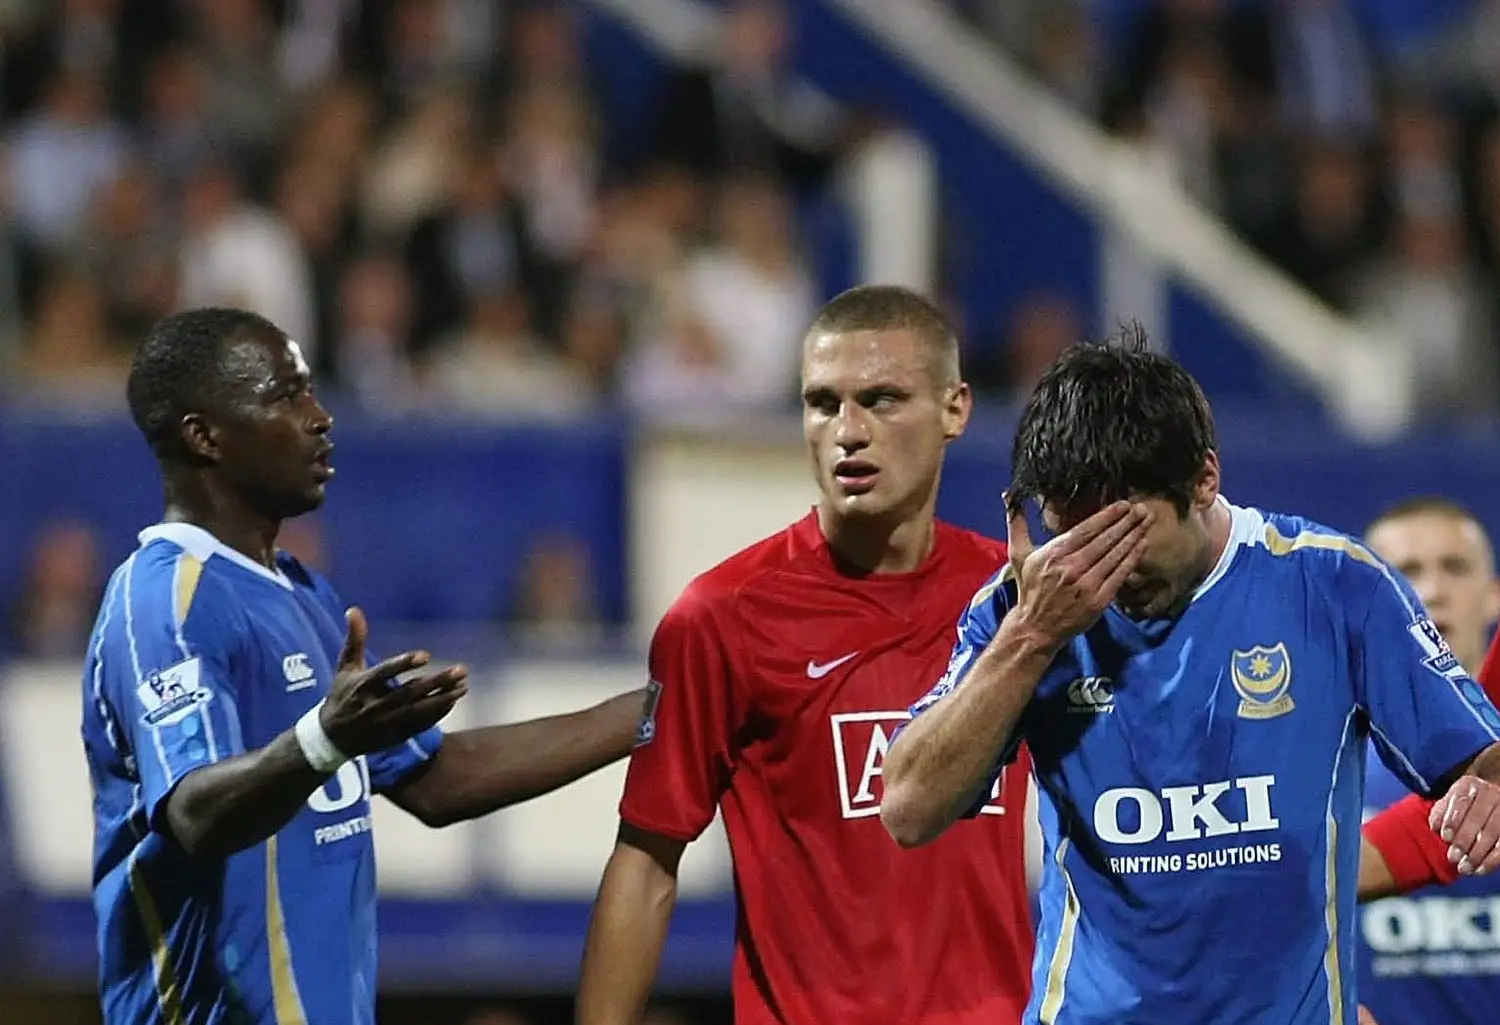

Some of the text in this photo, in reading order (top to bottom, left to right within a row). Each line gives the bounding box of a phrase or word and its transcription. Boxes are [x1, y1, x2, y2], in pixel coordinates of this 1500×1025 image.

[1094, 775, 1279, 844] OKI
[1105, 844, 1281, 874] RINTING SOLUTIONS
